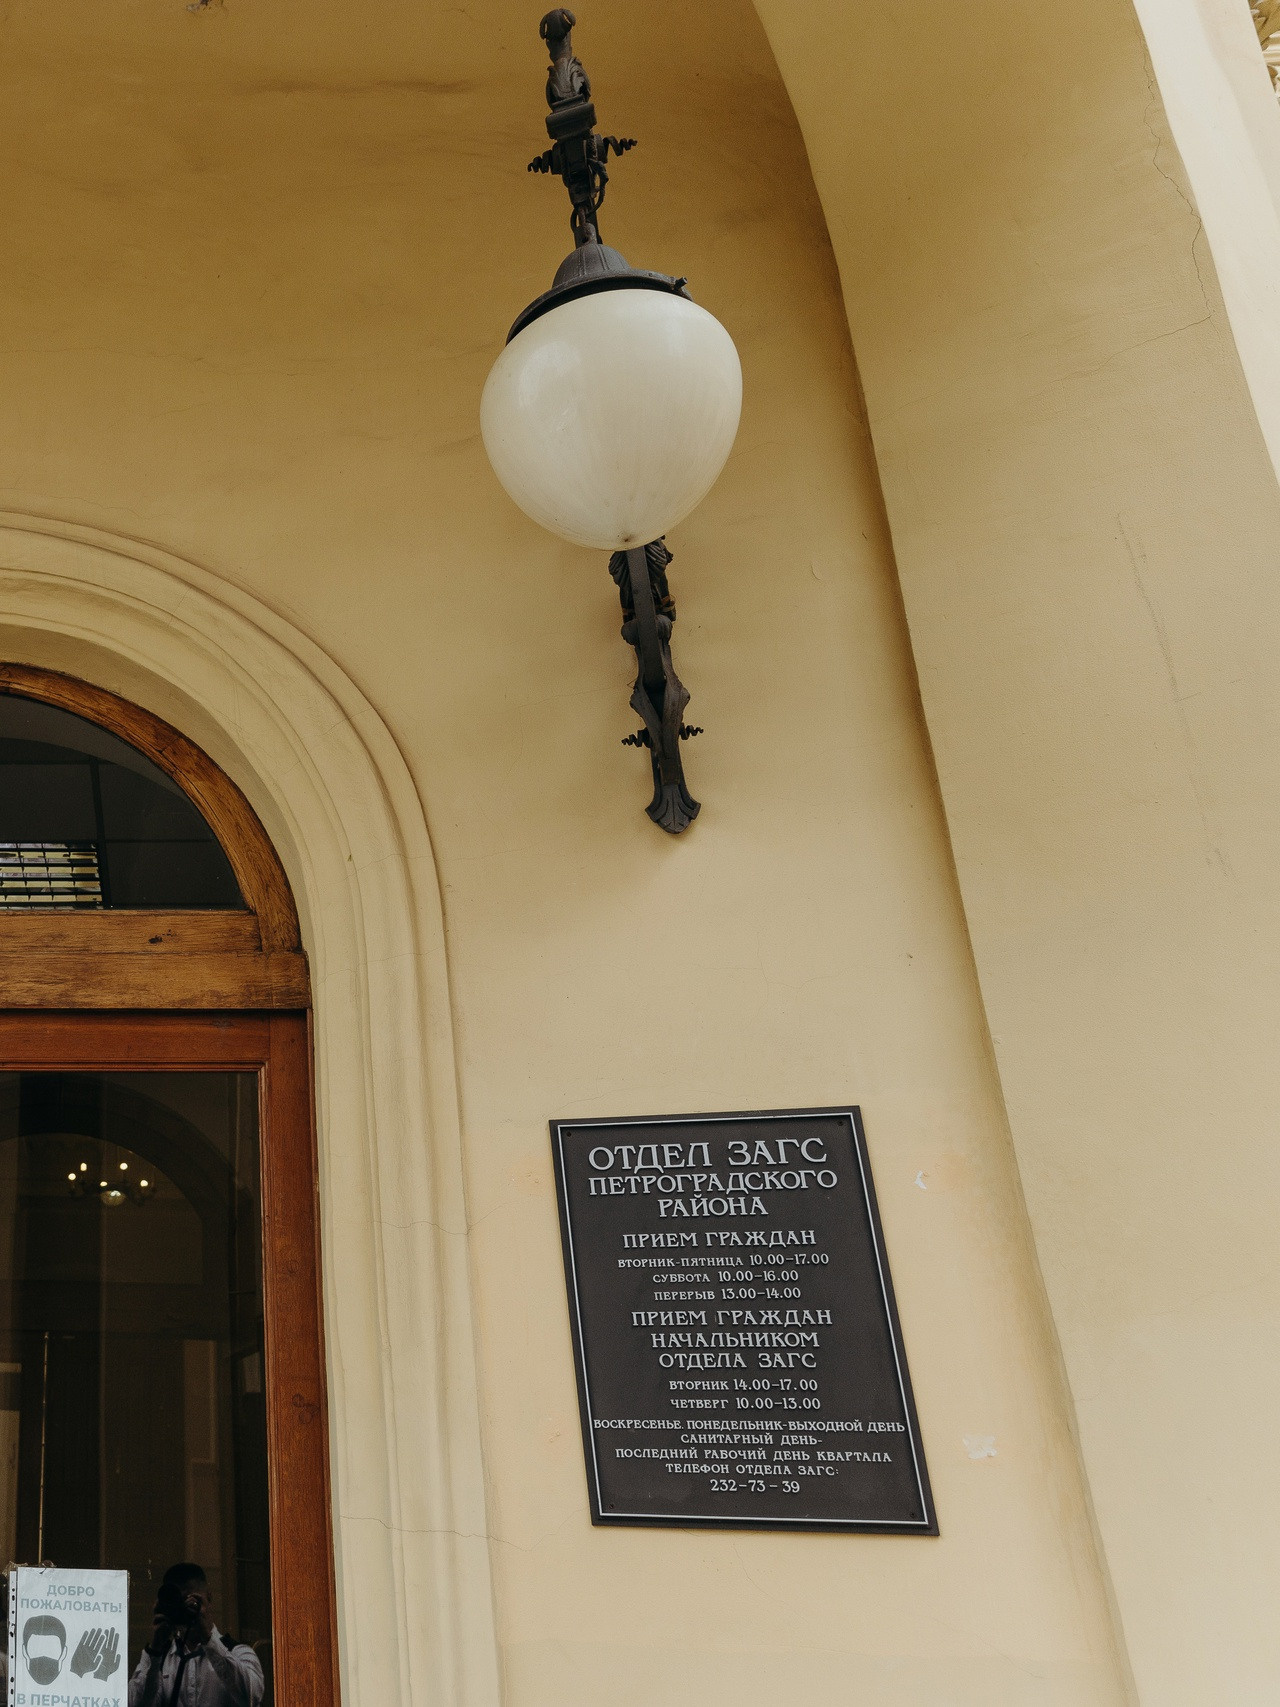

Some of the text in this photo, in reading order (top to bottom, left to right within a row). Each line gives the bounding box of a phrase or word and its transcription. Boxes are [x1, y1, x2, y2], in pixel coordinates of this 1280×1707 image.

[589, 1138, 826, 1174] ОТДЕЛ ЗАГС
[589, 1170, 837, 1195] ПЕТРОГРАДСКОГО
[658, 1194, 768, 1217] РАЙОНА
[623, 1230, 816, 1248] ПРИЕМ ГРАЖДАН
[653, 1273, 710, 1282] СУББОТА
[654, 1290, 715, 1300] ПЕРЕРЫВ
[632, 1310, 832, 1327] ПРИЕМ ГРАЖДАН
[651, 1333, 819, 1347] НАЧАЛЬНИКОМ
[659, 1353, 816, 1370] ОТДЕЛА ЗАГС
[669, 1380, 729, 1389] ВТОРНИК
[671, 1399, 728, 1408] ЧЕТВЕРГ
[868, 1421, 905, 1433] ДЕНЬ
[681, 1432, 773, 1444] САНИТАРНЫЙ
[615, 1446, 891, 1462] ПОСЛЕДНИЙ РАБОЧИЙ ДЕНЬ КВАРТАЛА
[666, 1463, 838, 1475] ТЕЛЕФОН ОТДЕЛА ЗАГС:
[46, 1584, 95, 1597] ДОБРО
[20, 1598, 122, 1613] ПОЖАЛОВАТЬ!
[17, 1693, 26, 1704] В
